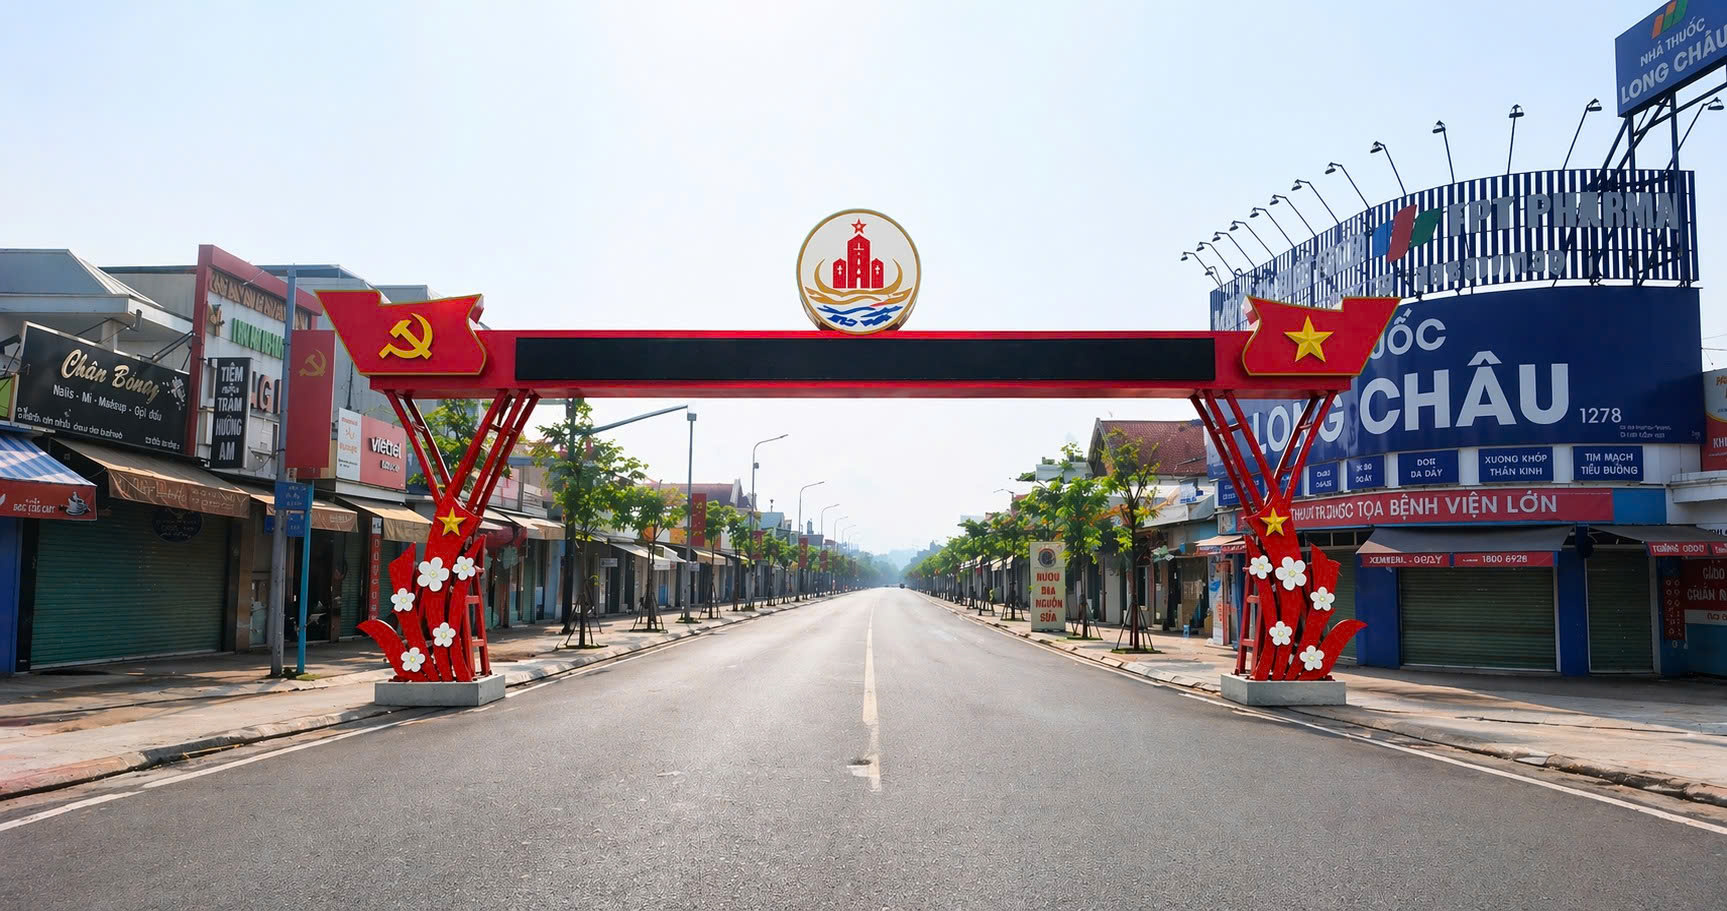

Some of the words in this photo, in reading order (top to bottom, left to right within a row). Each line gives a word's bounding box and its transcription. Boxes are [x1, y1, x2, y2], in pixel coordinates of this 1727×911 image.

[1621, 62, 1669, 105] LONG
[1527, 191, 1679, 230] PHARMA
[1359, 350, 1570, 435] CHÂU
[1579, 408, 1622, 424] 1278
[1585, 453, 1601, 462] TIM
[1519, 466, 1543, 475] KINH
[1390, 494, 1438, 520] BỆNH
[1445, 491, 1498, 518] VIỆN
[1507, 490, 1557, 513] LỚN
[1482, 554, 1503, 563] 1800
[1505, 554, 1528, 563] 6928
